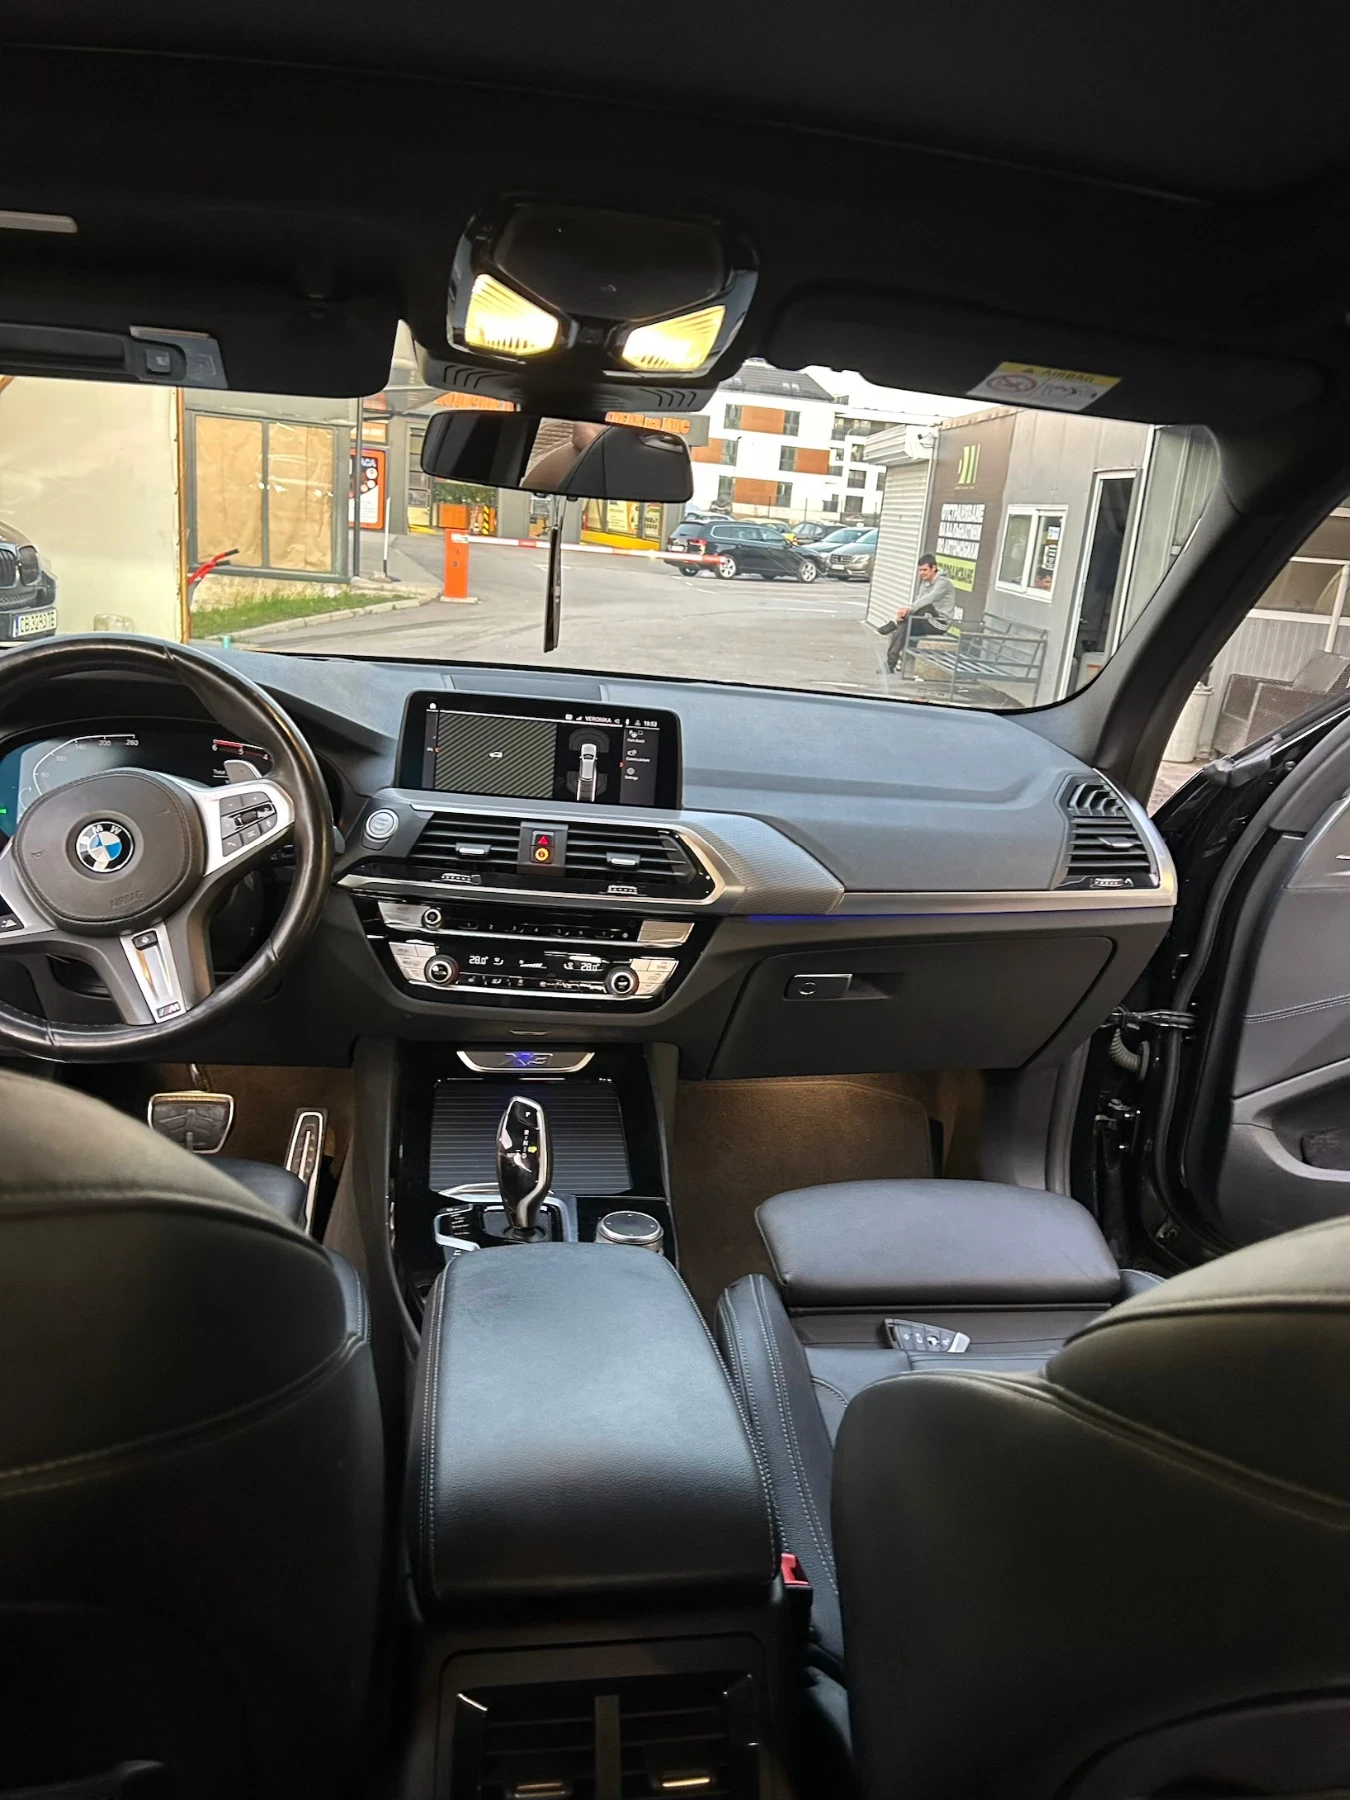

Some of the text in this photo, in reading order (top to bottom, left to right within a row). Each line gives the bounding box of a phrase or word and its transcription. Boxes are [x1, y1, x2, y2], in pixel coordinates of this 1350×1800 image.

[1043, 369, 1096, 383] AIRBAG
[98, 739, 112, 747] 200
[211, 743, 218, 752] 6
[238, 747, 244, 756] 5
[262, 753, 269, 761] 4
